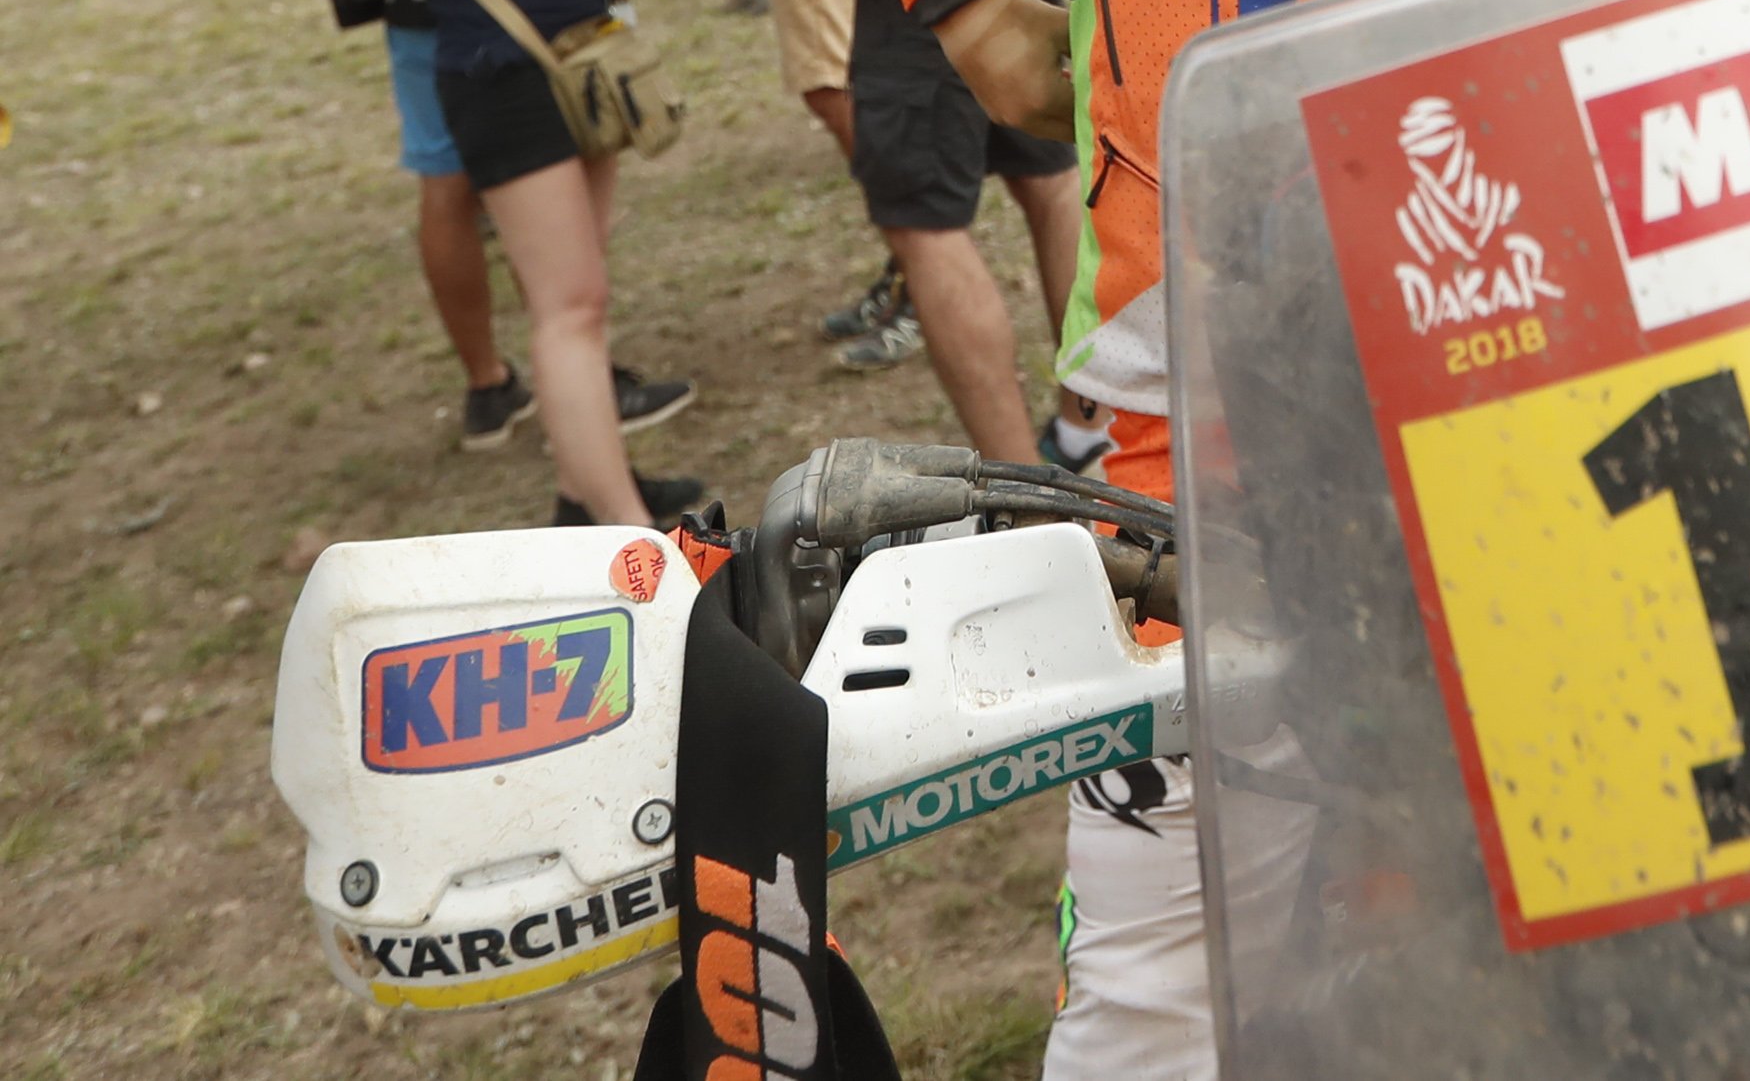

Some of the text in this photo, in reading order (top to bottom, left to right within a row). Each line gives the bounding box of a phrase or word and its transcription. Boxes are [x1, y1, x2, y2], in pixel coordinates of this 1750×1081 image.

[1394, 233, 1566, 338] DAKAR
[1444, 319, 1547, 375] 2018
[622, 548, 649, 601] SAFETY
[379, 625, 614, 751] KH-7
[850, 715, 1137, 854] MOTOREX
